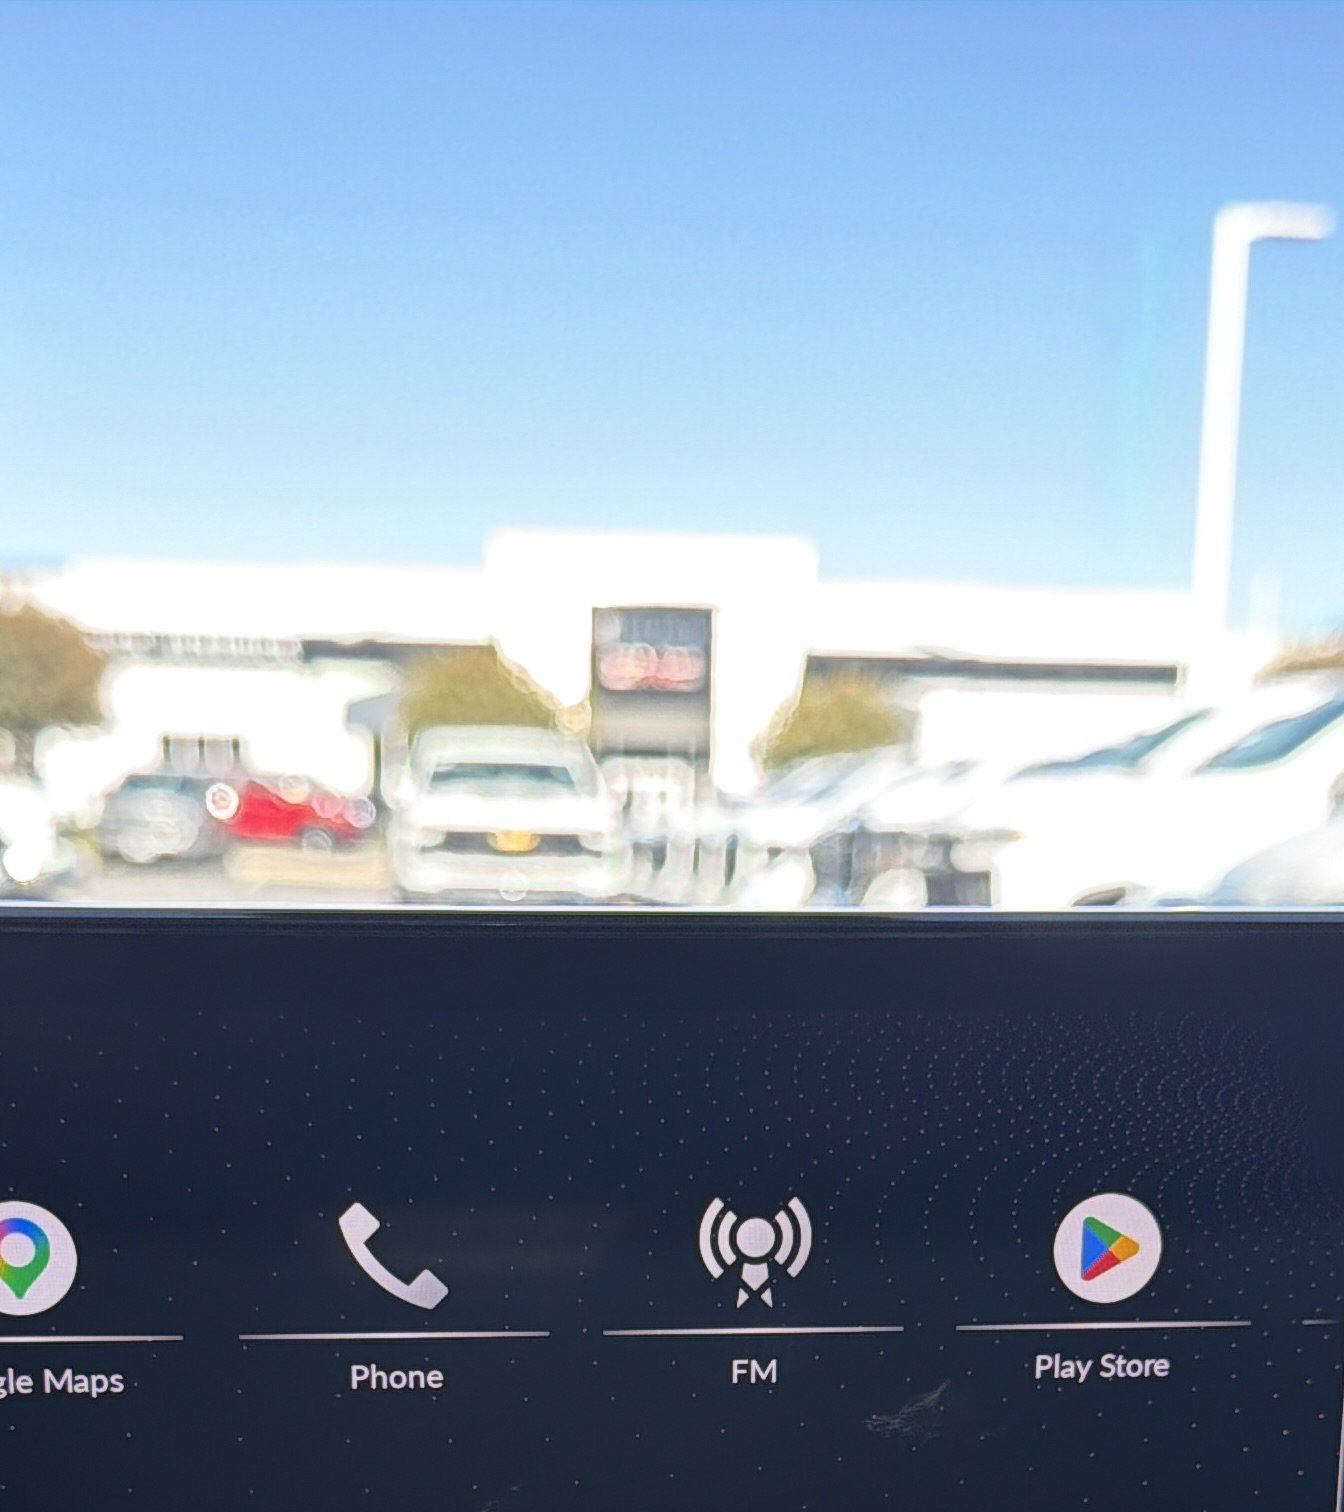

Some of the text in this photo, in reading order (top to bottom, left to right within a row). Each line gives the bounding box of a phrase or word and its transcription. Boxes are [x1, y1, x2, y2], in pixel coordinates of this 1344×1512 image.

[351, 1364, 443, 1389] Phone
[733, 1359, 776, 1383] FM
[1035, 1353, 1170, 1383] Play Store
[44, 1369, 124, 1398] Maps
